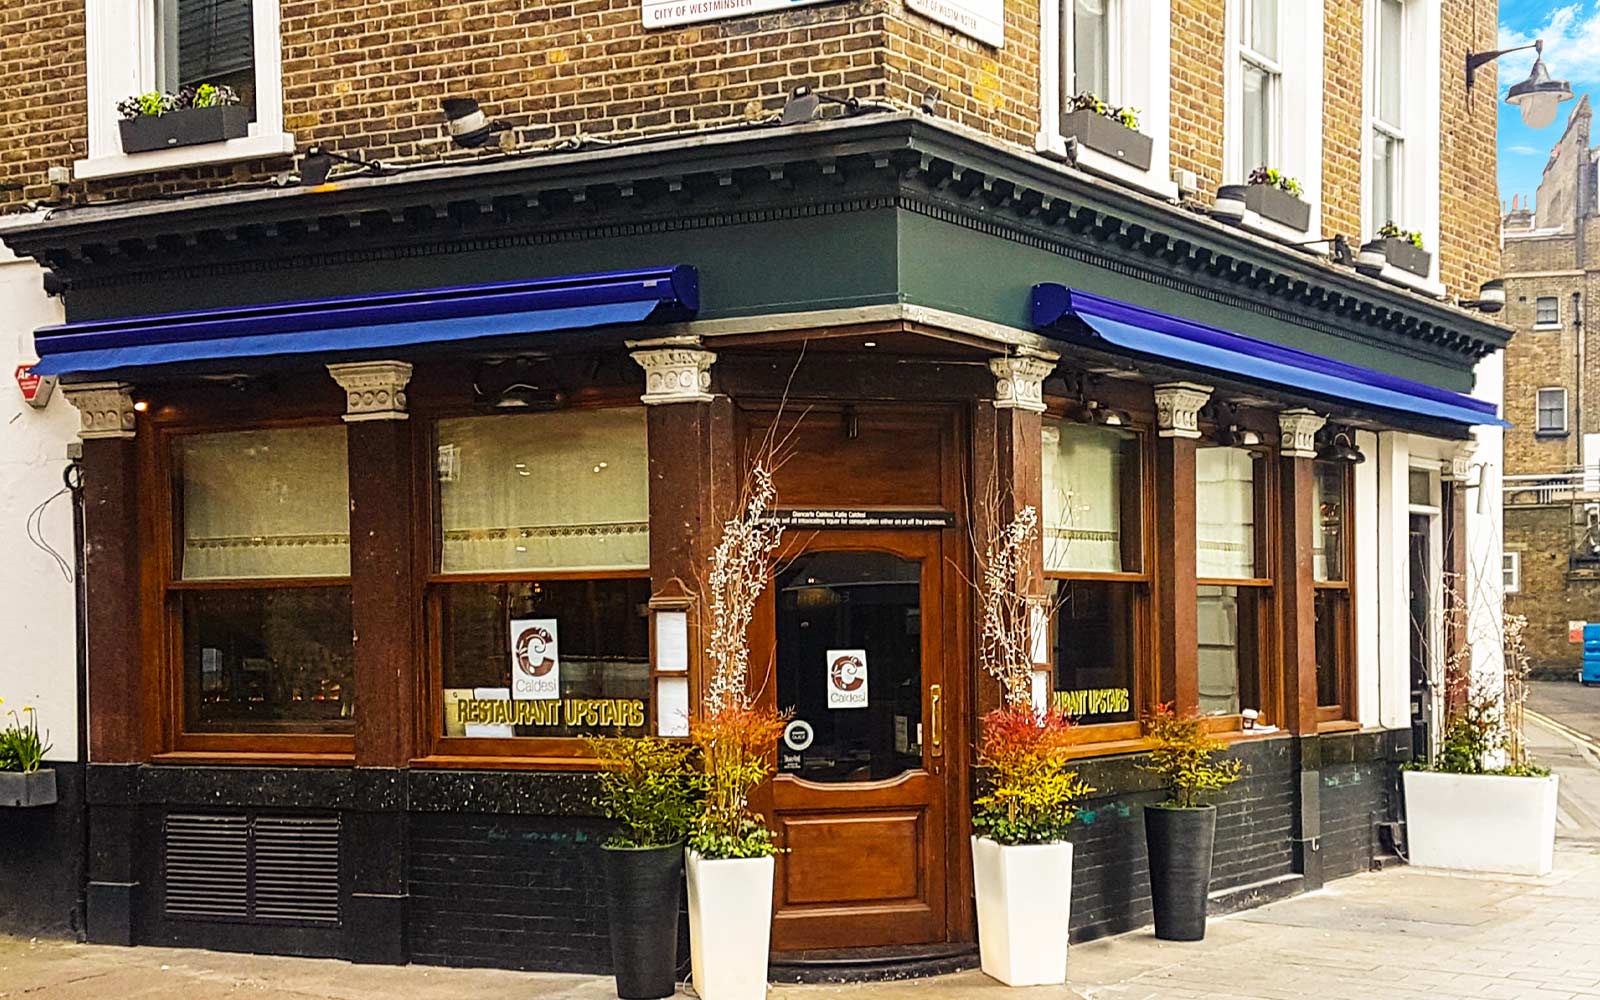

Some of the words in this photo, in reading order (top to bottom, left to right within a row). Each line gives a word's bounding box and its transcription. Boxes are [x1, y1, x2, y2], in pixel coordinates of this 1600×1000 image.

[654, 8, 673, 20] CITY
[676, 5, 686, 17] OF
[689, 0, 752, 15] WESTMINSTER
[516, 680, 557, 693] Caldesi
[831, 692, 866, 704] Caldesi
[1088, 688, 1130, 714] UPSTAIRS
[457, 698, 562, 726] RESTAURANT
[564, 698, 645, 726] UPSTAIRS
